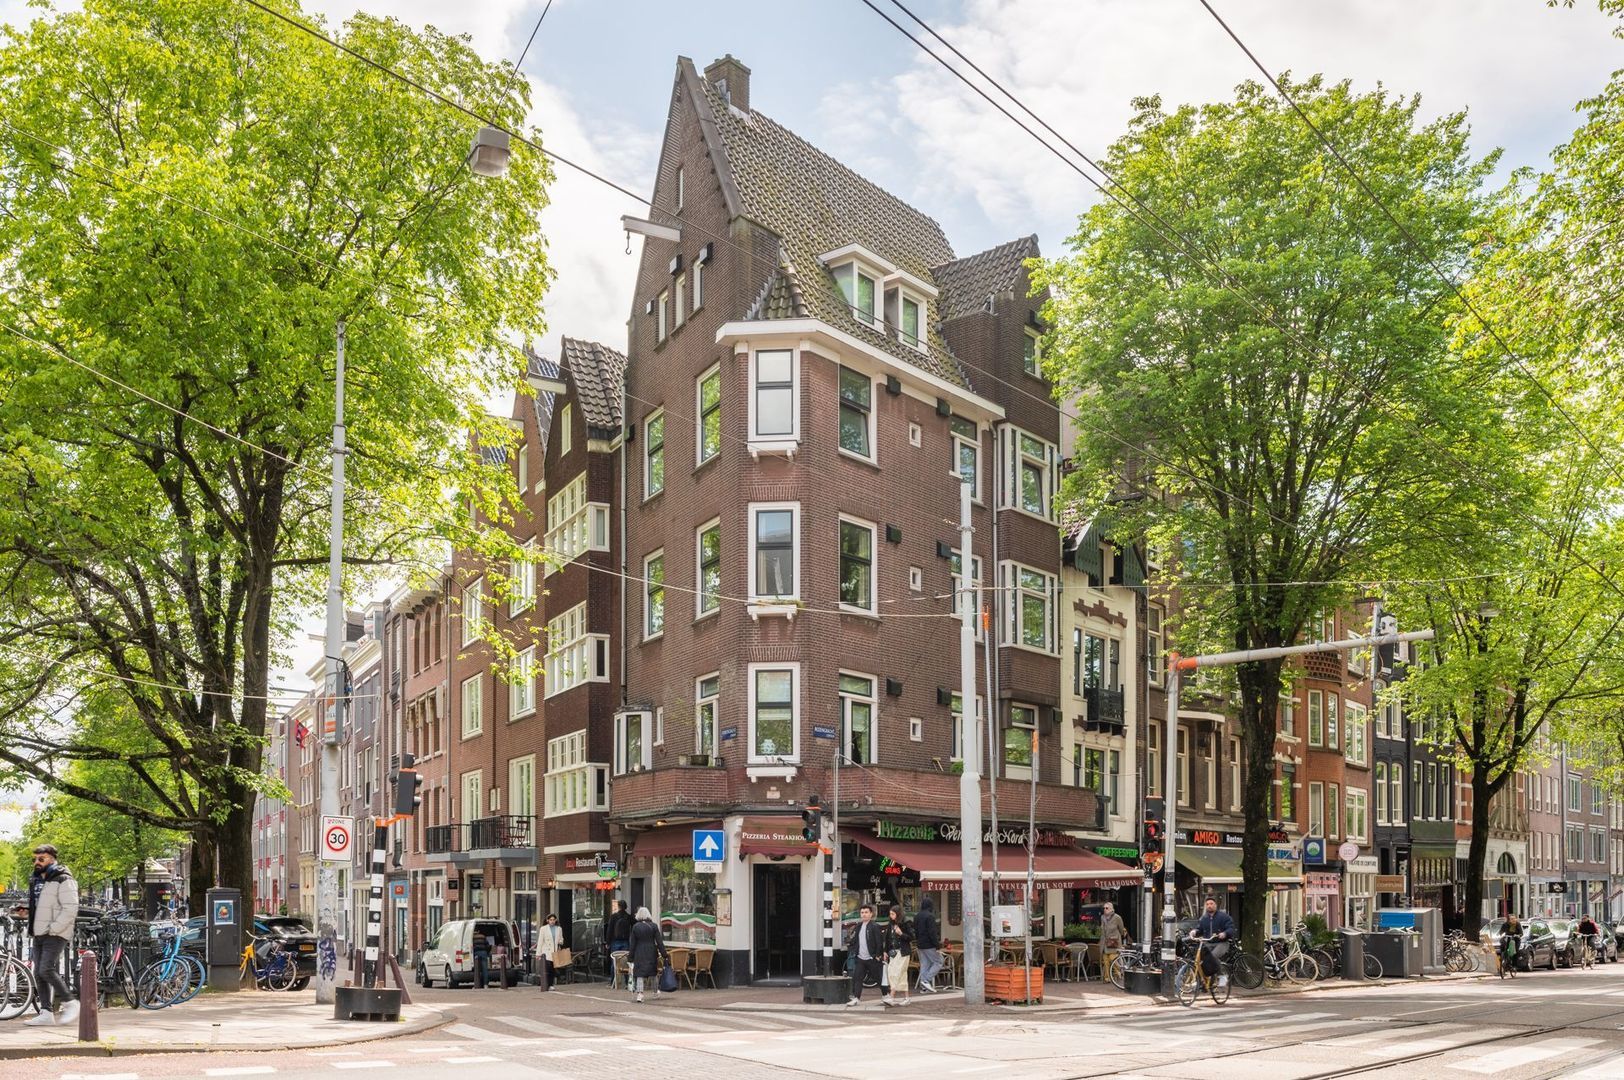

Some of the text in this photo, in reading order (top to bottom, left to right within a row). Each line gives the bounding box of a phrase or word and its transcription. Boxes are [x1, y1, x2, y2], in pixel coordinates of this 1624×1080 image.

[330, 833, 345, 844] 30
[742, 832, 770, 840] PIZZERIA
[1194, 832, 1220, 844] AMIGO
[1096, 846, 1138, 858] COFFEESHOP
[928, 882, 961, 891] PIZZER
